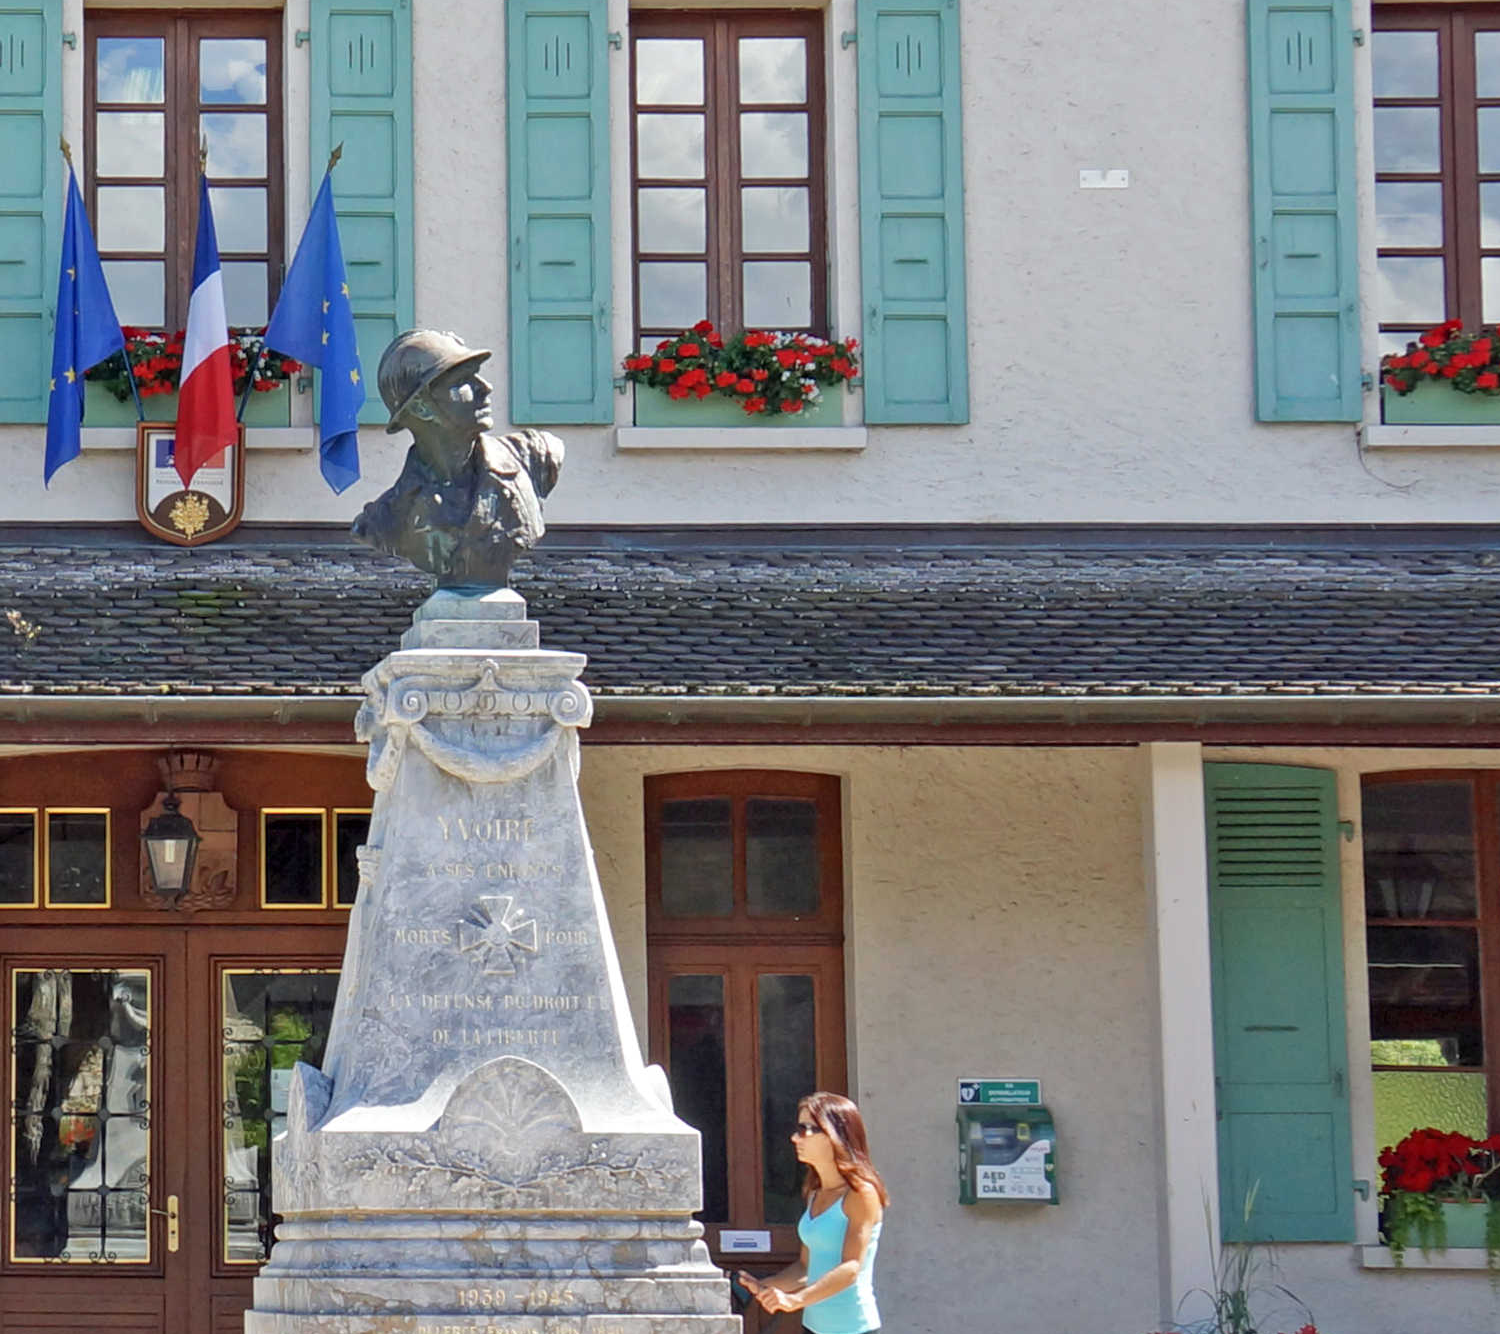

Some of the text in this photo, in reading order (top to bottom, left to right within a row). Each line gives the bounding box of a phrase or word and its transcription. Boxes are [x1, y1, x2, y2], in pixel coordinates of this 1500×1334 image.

[437, 816, 537, 842] YVOIRE
[445, 864, 476, 878] SES
[486, 864, 563, 879] ENFANTS
[394, 929, 589, 945] MORTS POUR
[504, 994, 525, 1009] DU
[533, 994, 580, 1010] DROIT
[982, 1171, 1006, 1180] AED
[982, 1184, 1006, 1193] DAE
[458, 1289, 506, 1306] 1939
[529, 1289, 574, 1306] 1945
